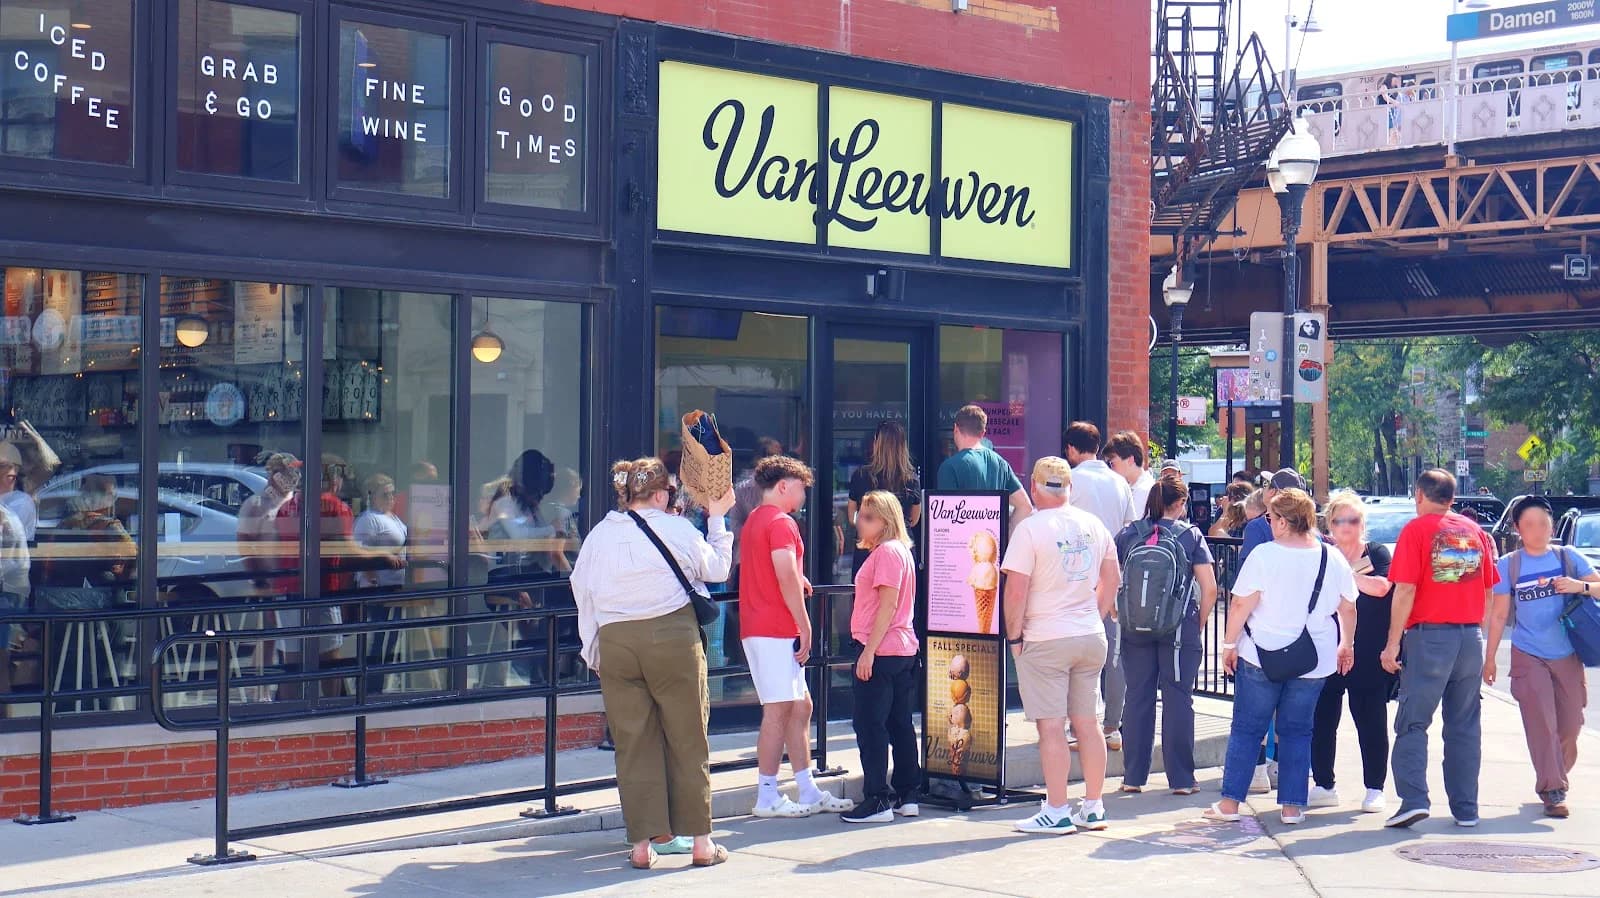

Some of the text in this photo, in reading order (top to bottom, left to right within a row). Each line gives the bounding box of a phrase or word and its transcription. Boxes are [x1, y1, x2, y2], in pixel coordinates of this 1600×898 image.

[1567, 0, 1594, 11] 2000W
[1489, 9, 1557, 31] Damen
[39, 13, 106, 71] ICED
[201, 55, 278, 84] GRAB
[14, 50, 119, 129] COFFEE
[366, 78, 425, 104] FINE
[205, 90, 272, 119] & GO
[498, 86, 576, 123] GOOD
[362, 115, 427, 143] WINE
[496, 130, 576, 164] TIMES
[702, 99, 1036, 233] Van Leeuwen
[930, 499, 1000, 524] Van Leeuwen
[1519, 588, 1557, 601] color
[933, 641, 997, 653] FALL SPECIALS
